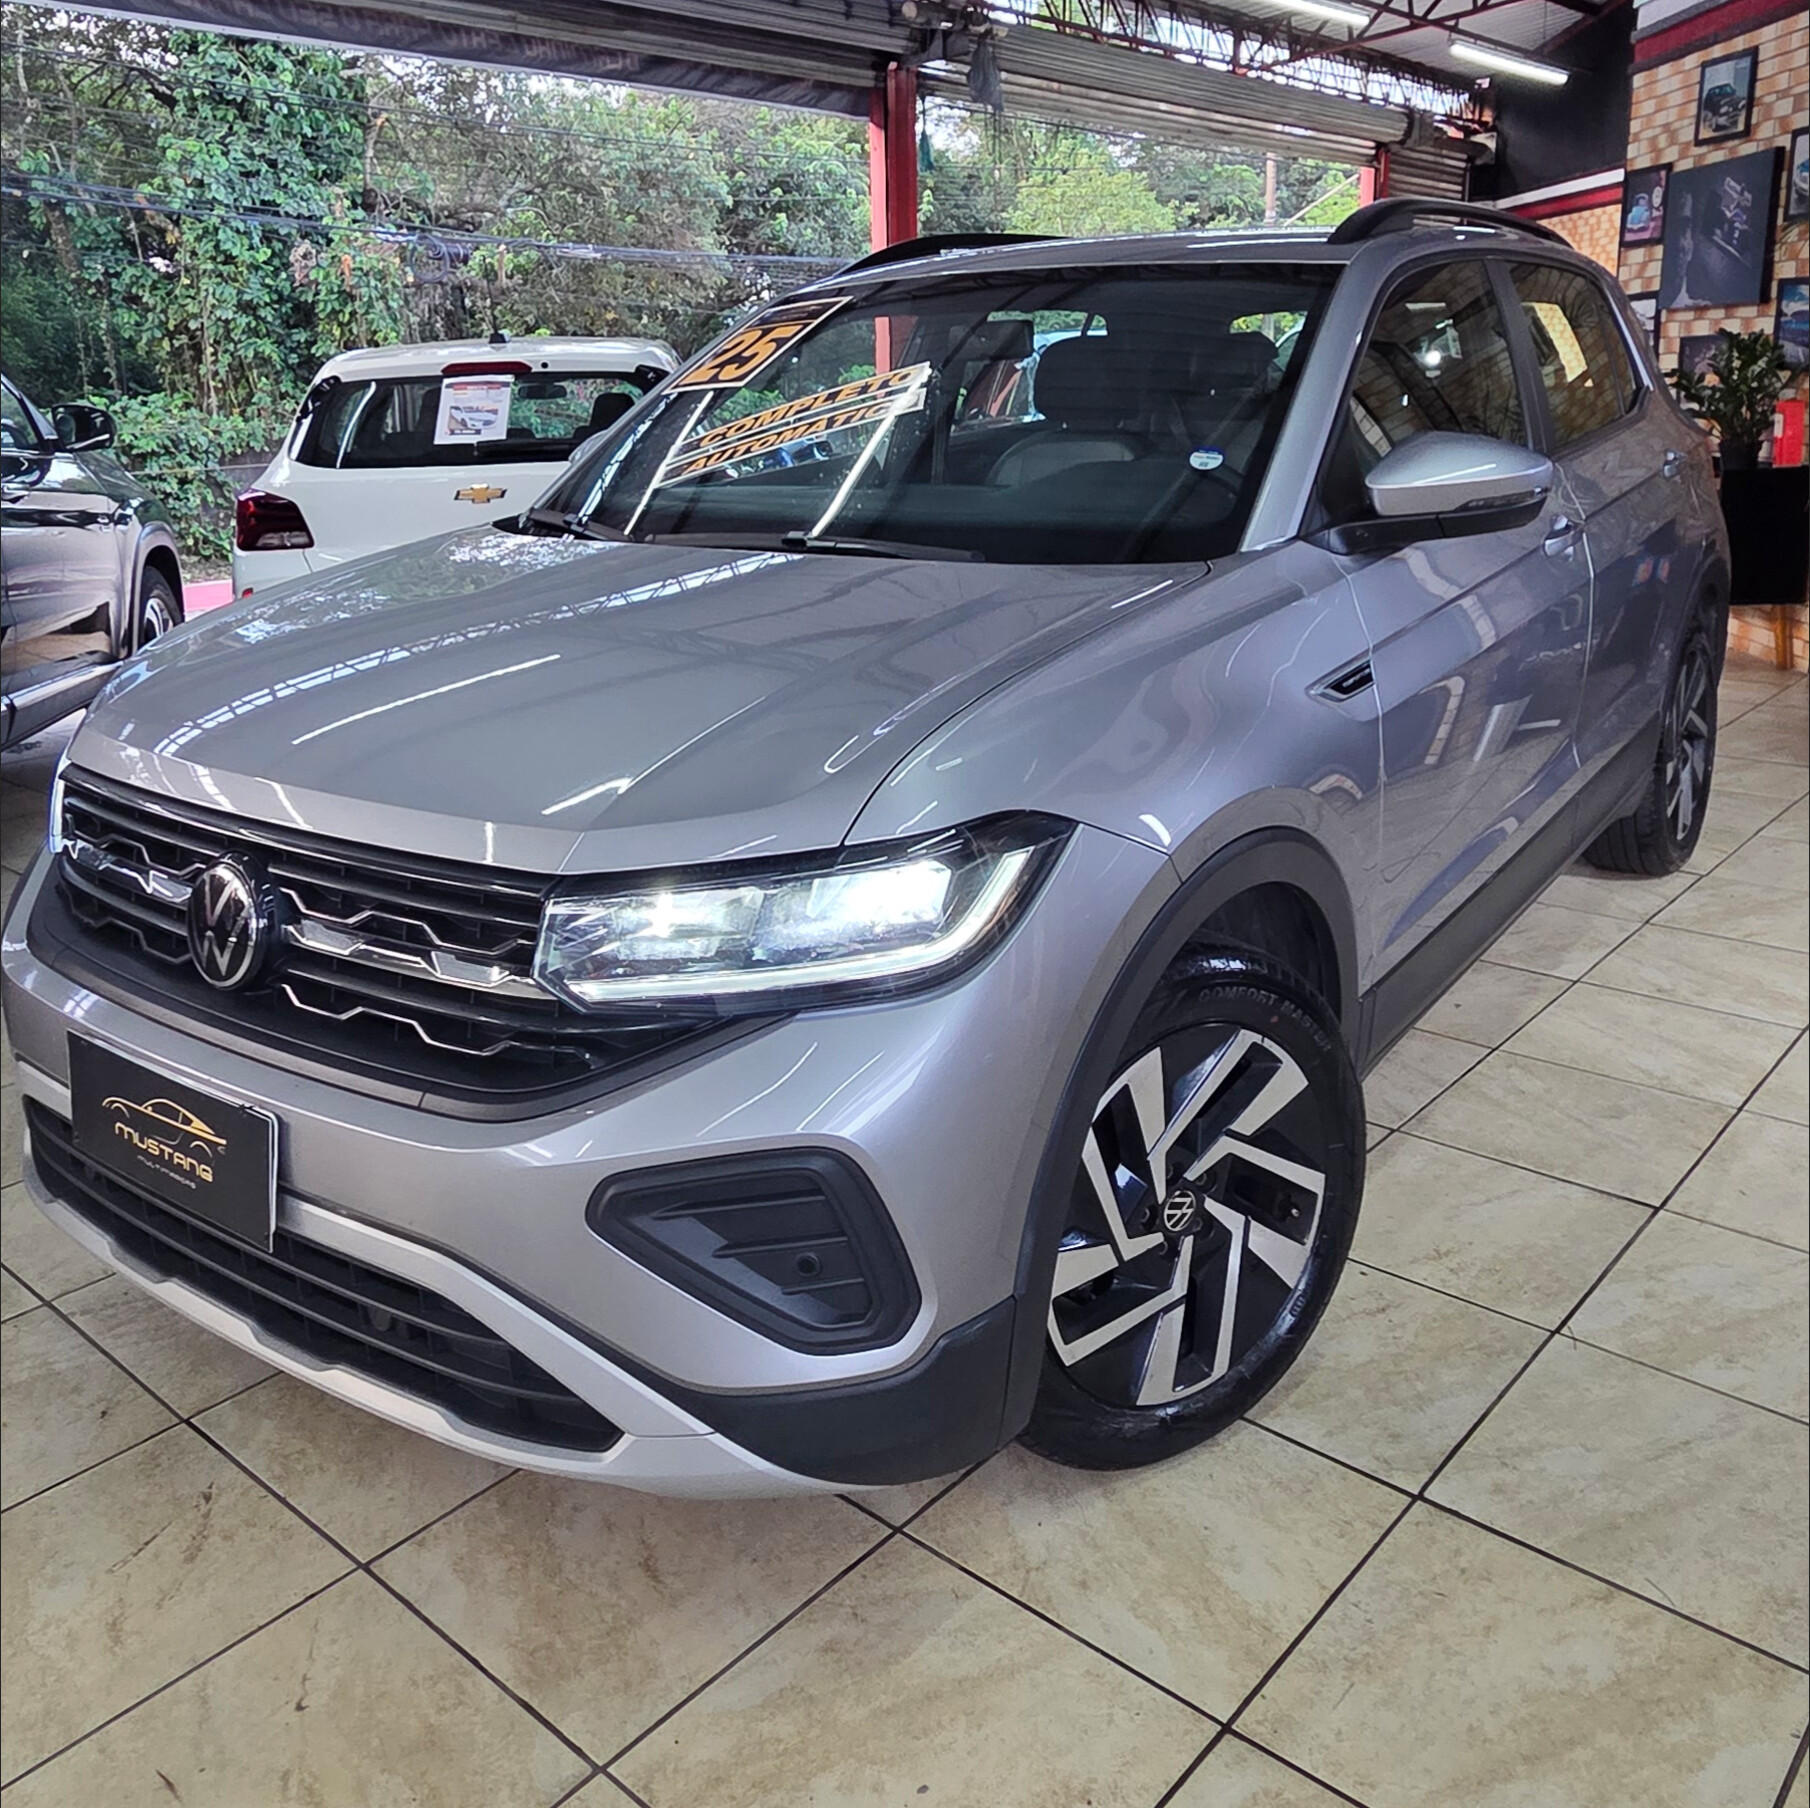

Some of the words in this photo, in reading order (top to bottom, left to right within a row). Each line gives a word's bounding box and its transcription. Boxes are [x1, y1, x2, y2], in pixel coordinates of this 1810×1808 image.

[679, 324, 805, 385] 25
[681, 392, 918, 475] AUTOMATIC
[699, 367, 917, 448] COMPLETO
[114, 1121, 214, 1183] MUSTANG
